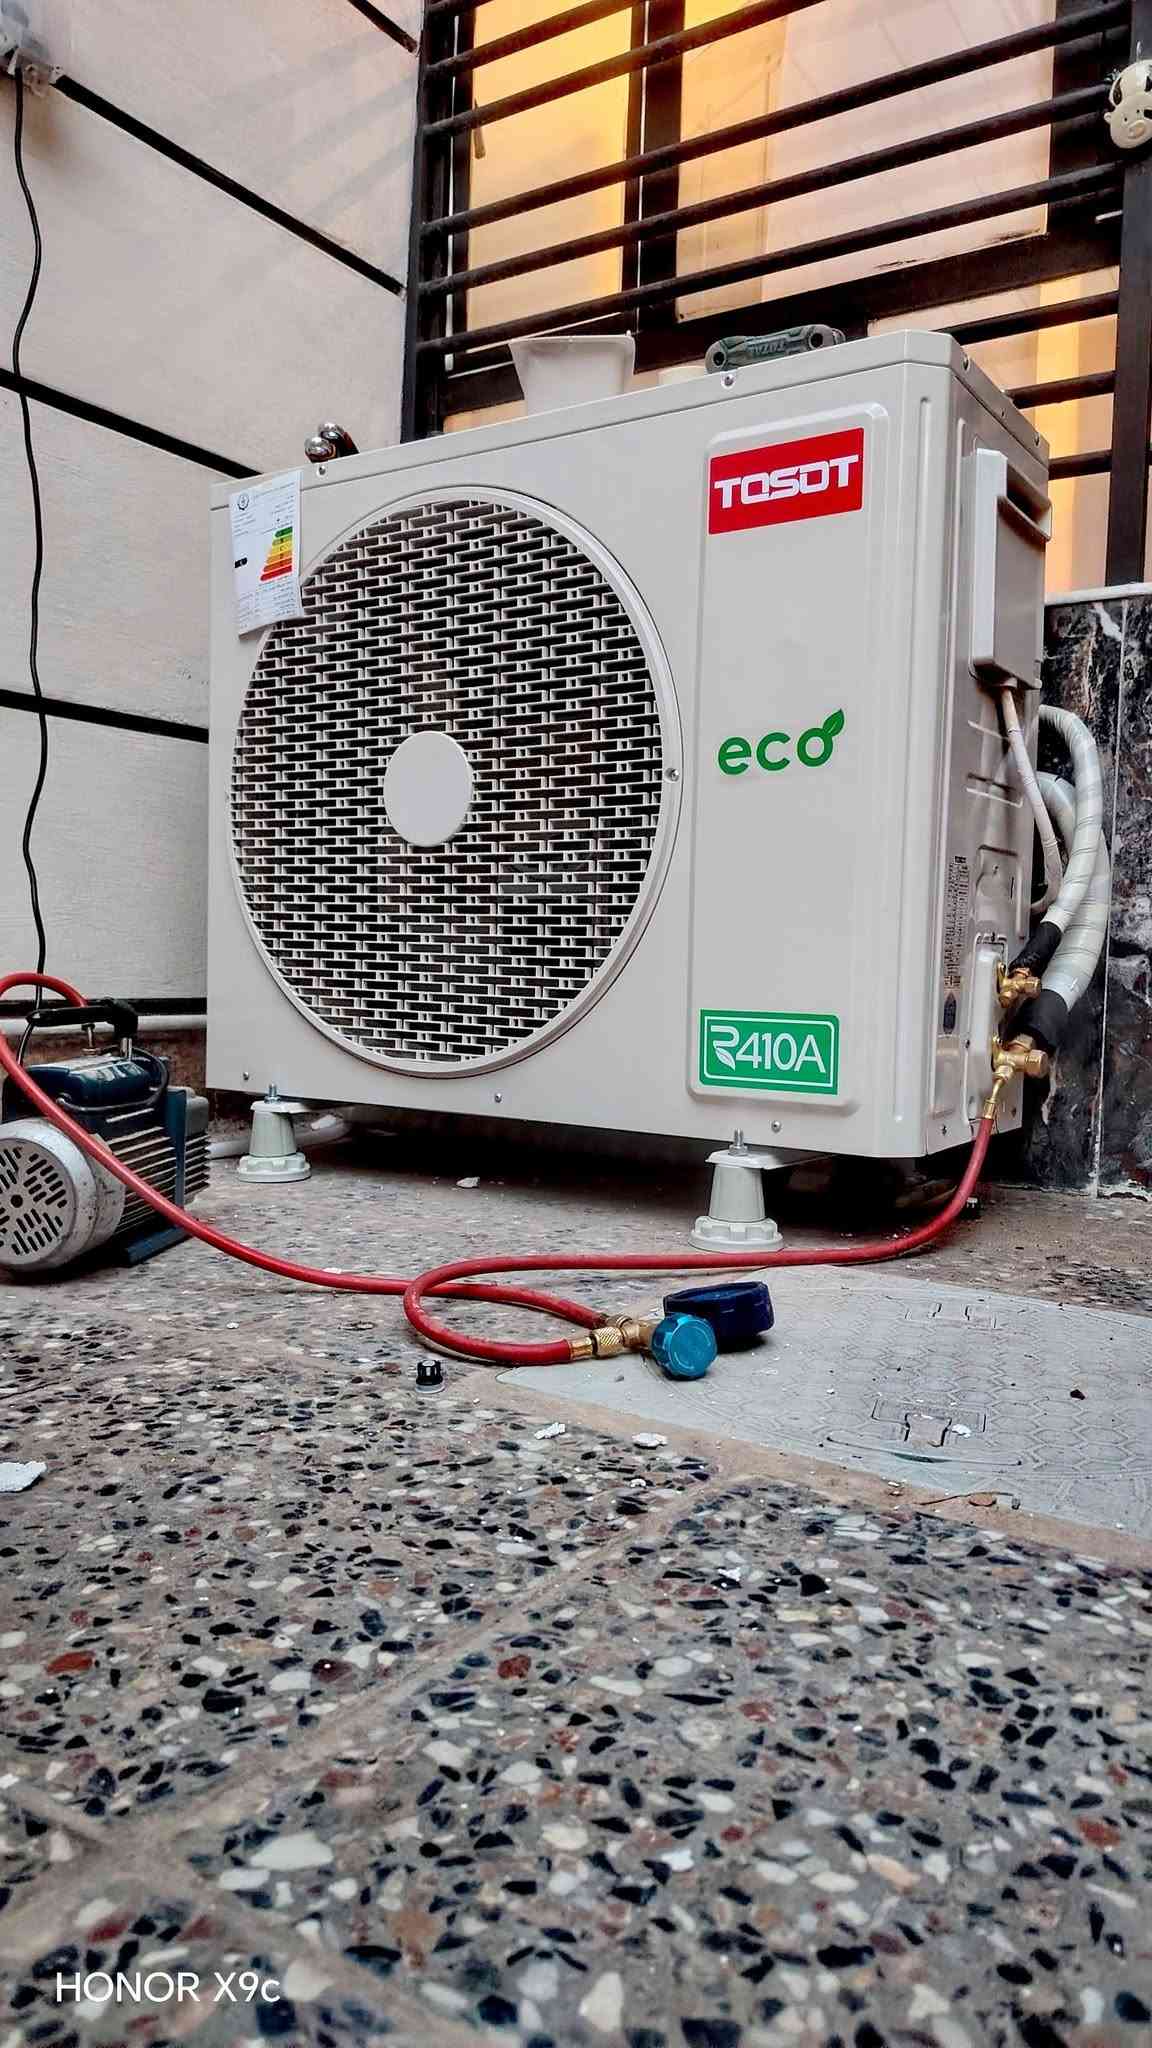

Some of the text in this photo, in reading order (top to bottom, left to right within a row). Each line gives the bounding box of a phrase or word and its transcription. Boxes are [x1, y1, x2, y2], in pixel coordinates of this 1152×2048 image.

[714, 454, 859, 509] TOSOT
[718, 708, 845, 775] eco
[710, 1025, 826, 1073] R410A
